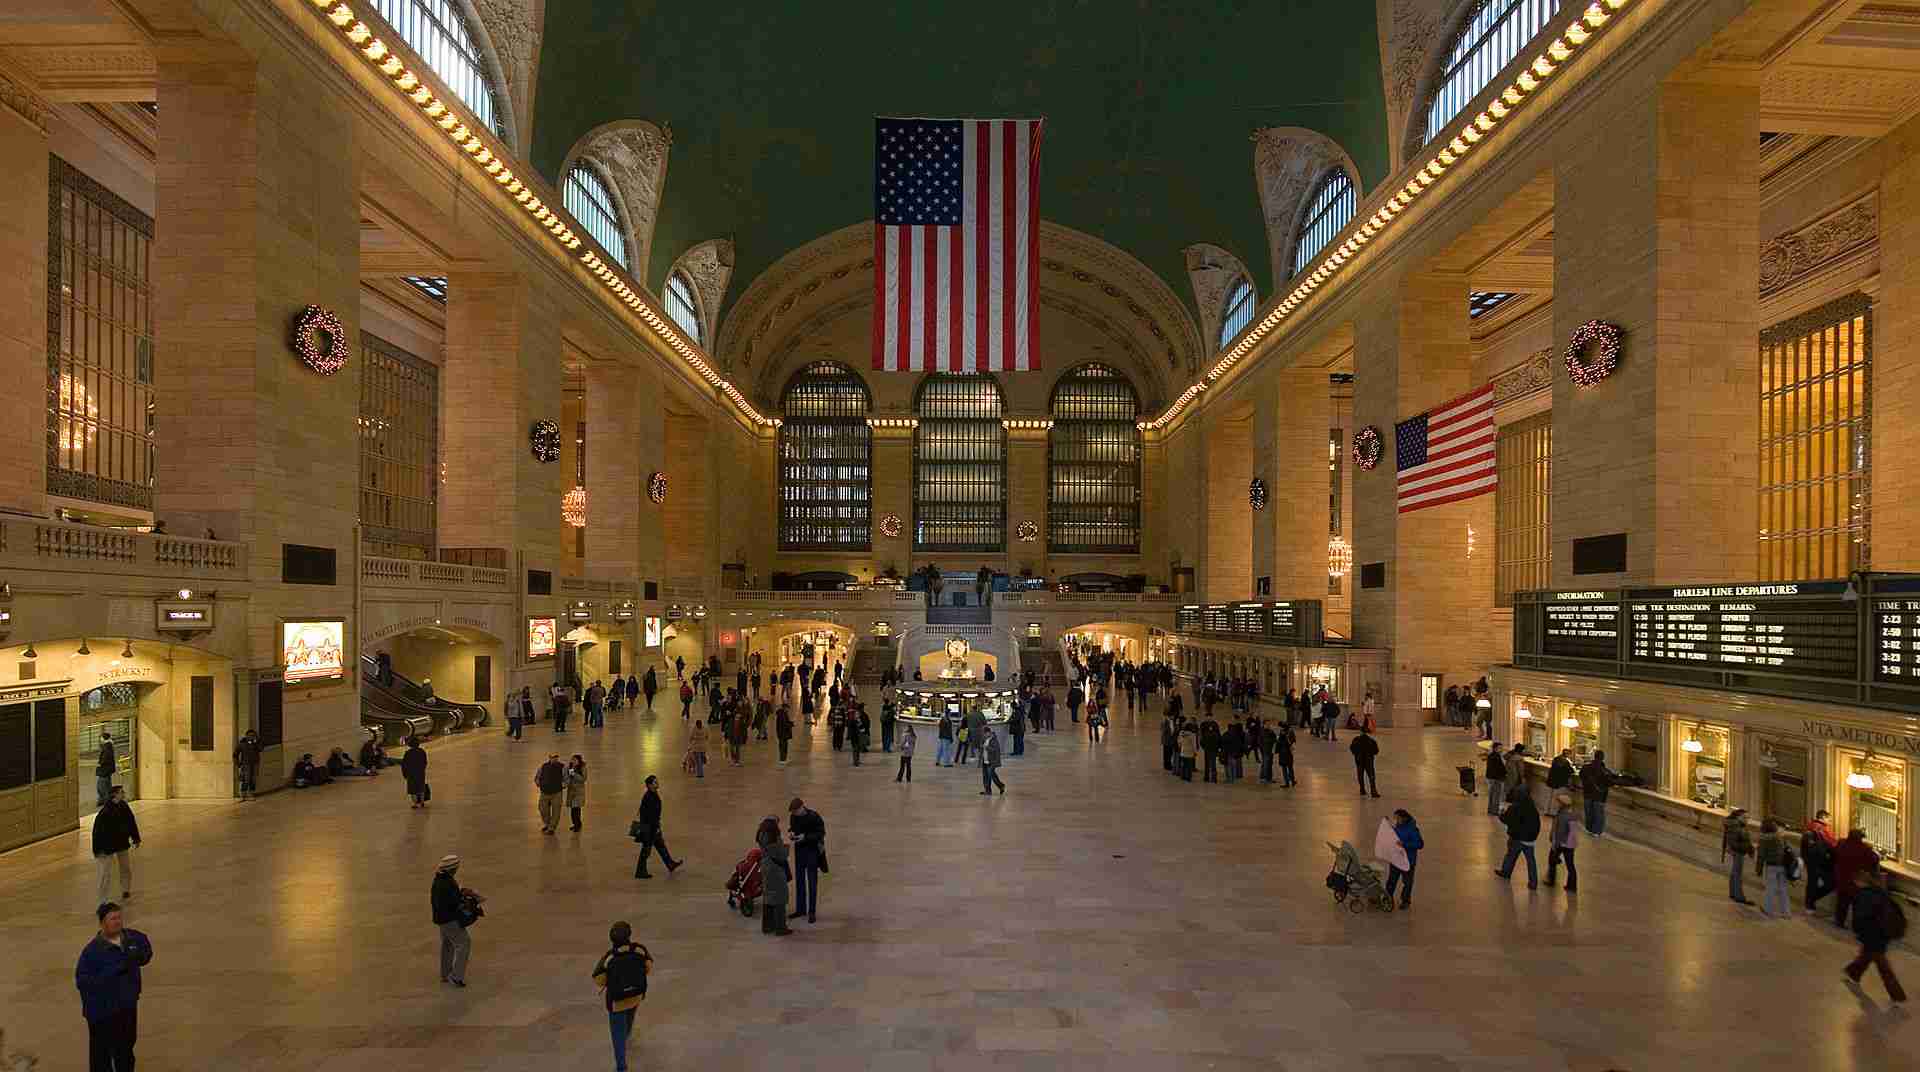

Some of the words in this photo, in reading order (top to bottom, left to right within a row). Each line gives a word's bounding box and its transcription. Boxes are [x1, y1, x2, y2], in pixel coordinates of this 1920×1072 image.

[1557, 591, 1604, 600] INFORMATION
[1673, 588, 1710, 597] HARLEM
[1711, 587, 1734, 596] LINE
[1735, 585, 1798, 596] DEPARTURES
[1879, 601, 1900, 610] TIME
[1905, 601, 1920, 610] TR
[1800, 719, 1833, 736] MTA
